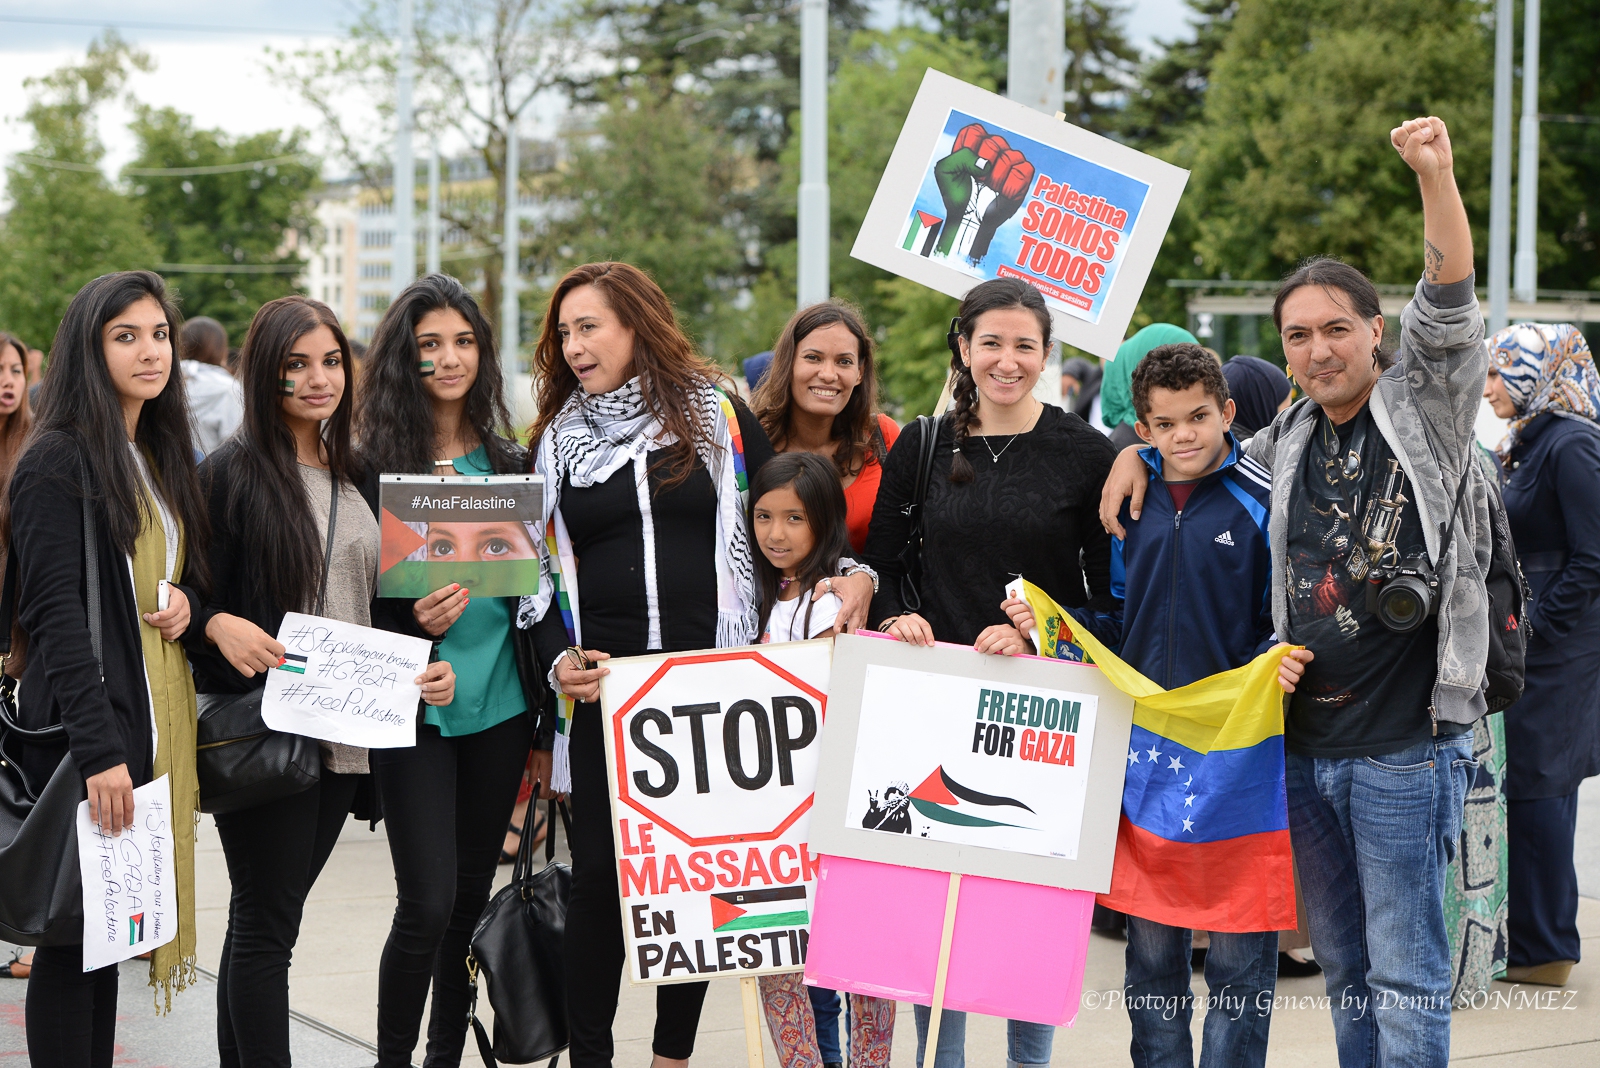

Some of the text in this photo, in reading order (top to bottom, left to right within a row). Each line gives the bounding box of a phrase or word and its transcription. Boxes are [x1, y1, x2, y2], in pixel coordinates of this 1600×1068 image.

[1032, 174, 1129, 232] Palestina
[1021, 200, 1120, 263] SOMOS
[1015, 235, 1106, 295] TODOS
[1000, 268, 1019, 279] Fuera
[1060, 292, 1089, 308] asesinos
[410, 495, 516, 510] #AnaFalastine
[1214, 537, 1235, 547] adidas
[279, 683, 406, 727] #FreePalestine
[976, 688, 1081, 733] FREEDOM
[629, 695, 818, 799] STOP
[972, 722, 1076, 767] FOR GAZA
[619, 818, 656, 856] LE
[153, 890, 162, 907] our
[631, 904, 676, 939] EN
